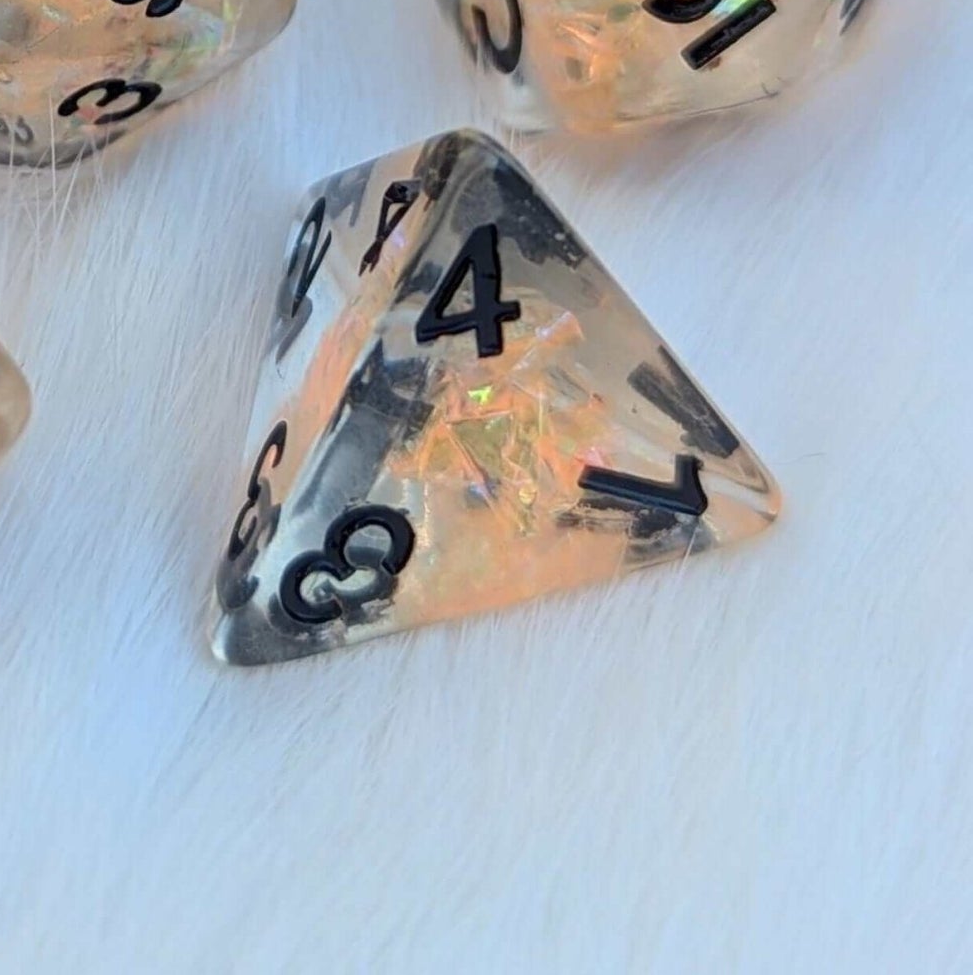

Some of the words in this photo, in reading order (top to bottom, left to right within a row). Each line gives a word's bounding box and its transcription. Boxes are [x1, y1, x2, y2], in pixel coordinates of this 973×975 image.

[58, 78, 162, 125] 3
[415, 224, 521, 358] 4
[577, 454, 709, 517] 1
